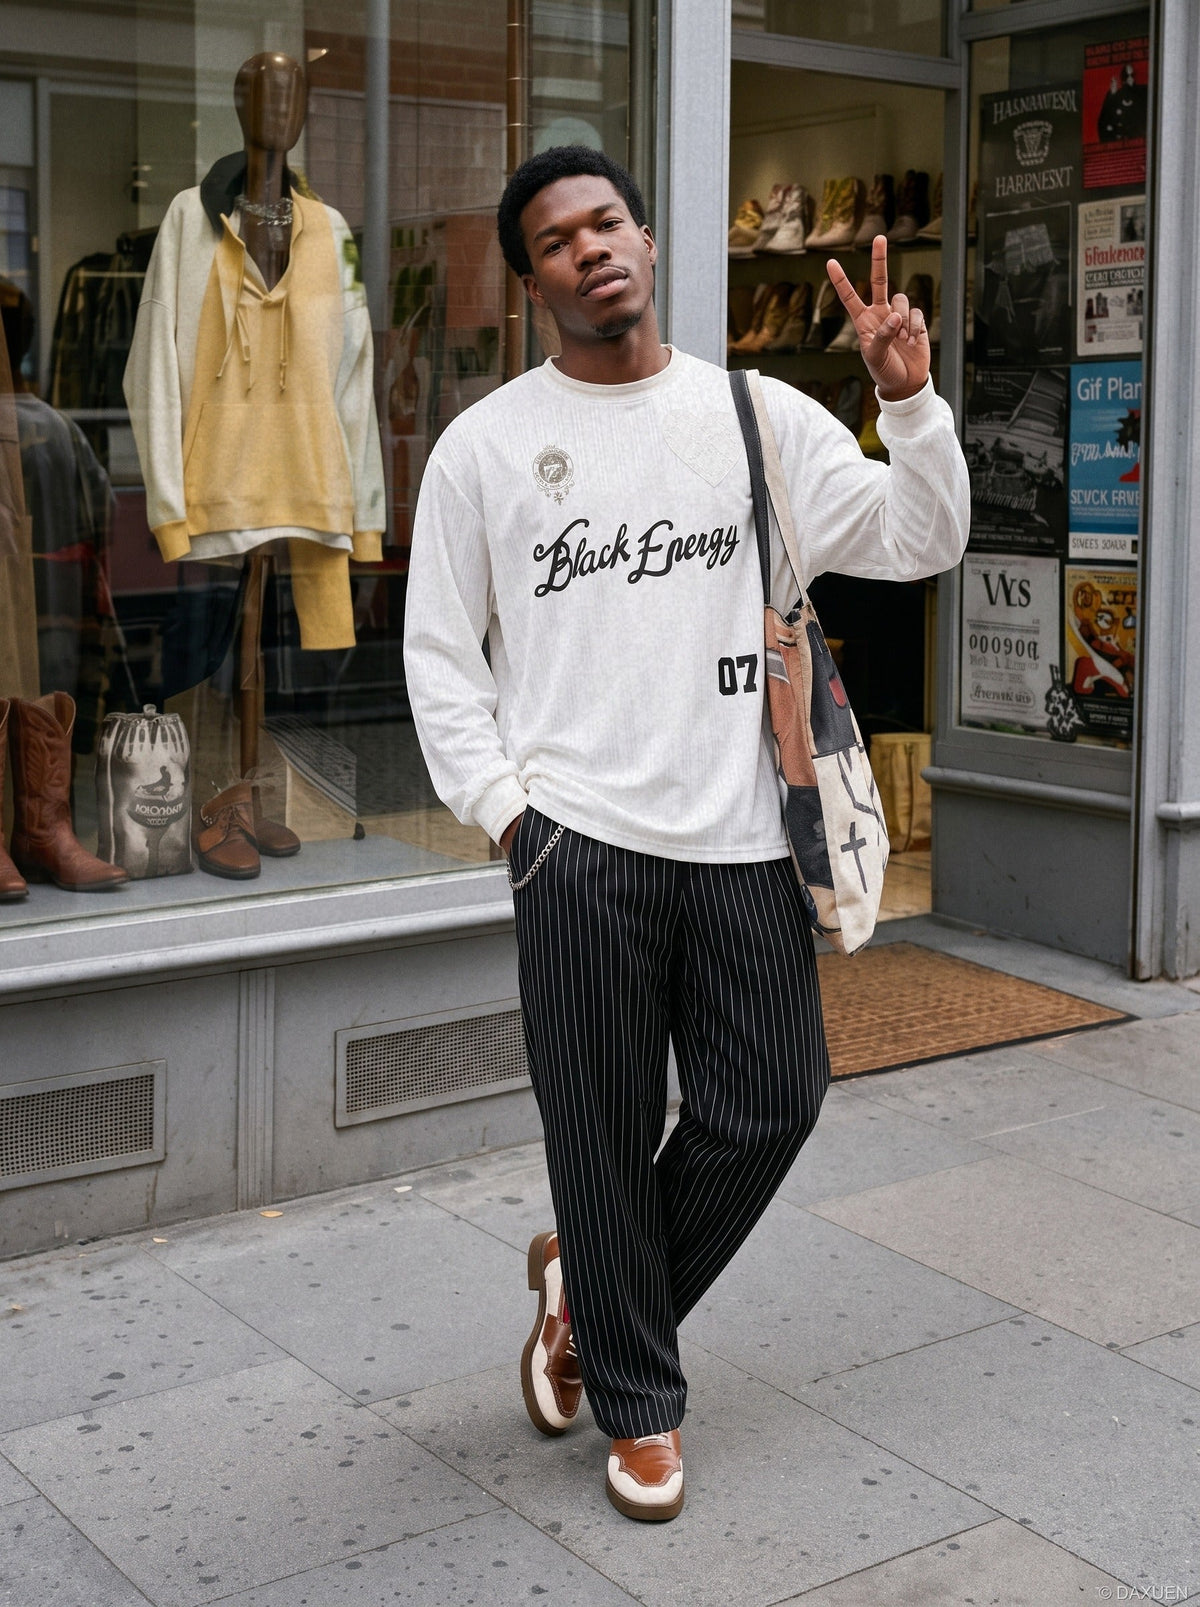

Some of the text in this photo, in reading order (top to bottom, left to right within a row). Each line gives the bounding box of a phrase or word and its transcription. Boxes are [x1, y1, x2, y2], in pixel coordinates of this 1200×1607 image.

[1077, 376, 1103, 401] Gif
[533, 518, 740, 598] Black Energy
[718, 653, 758, 696] 07
